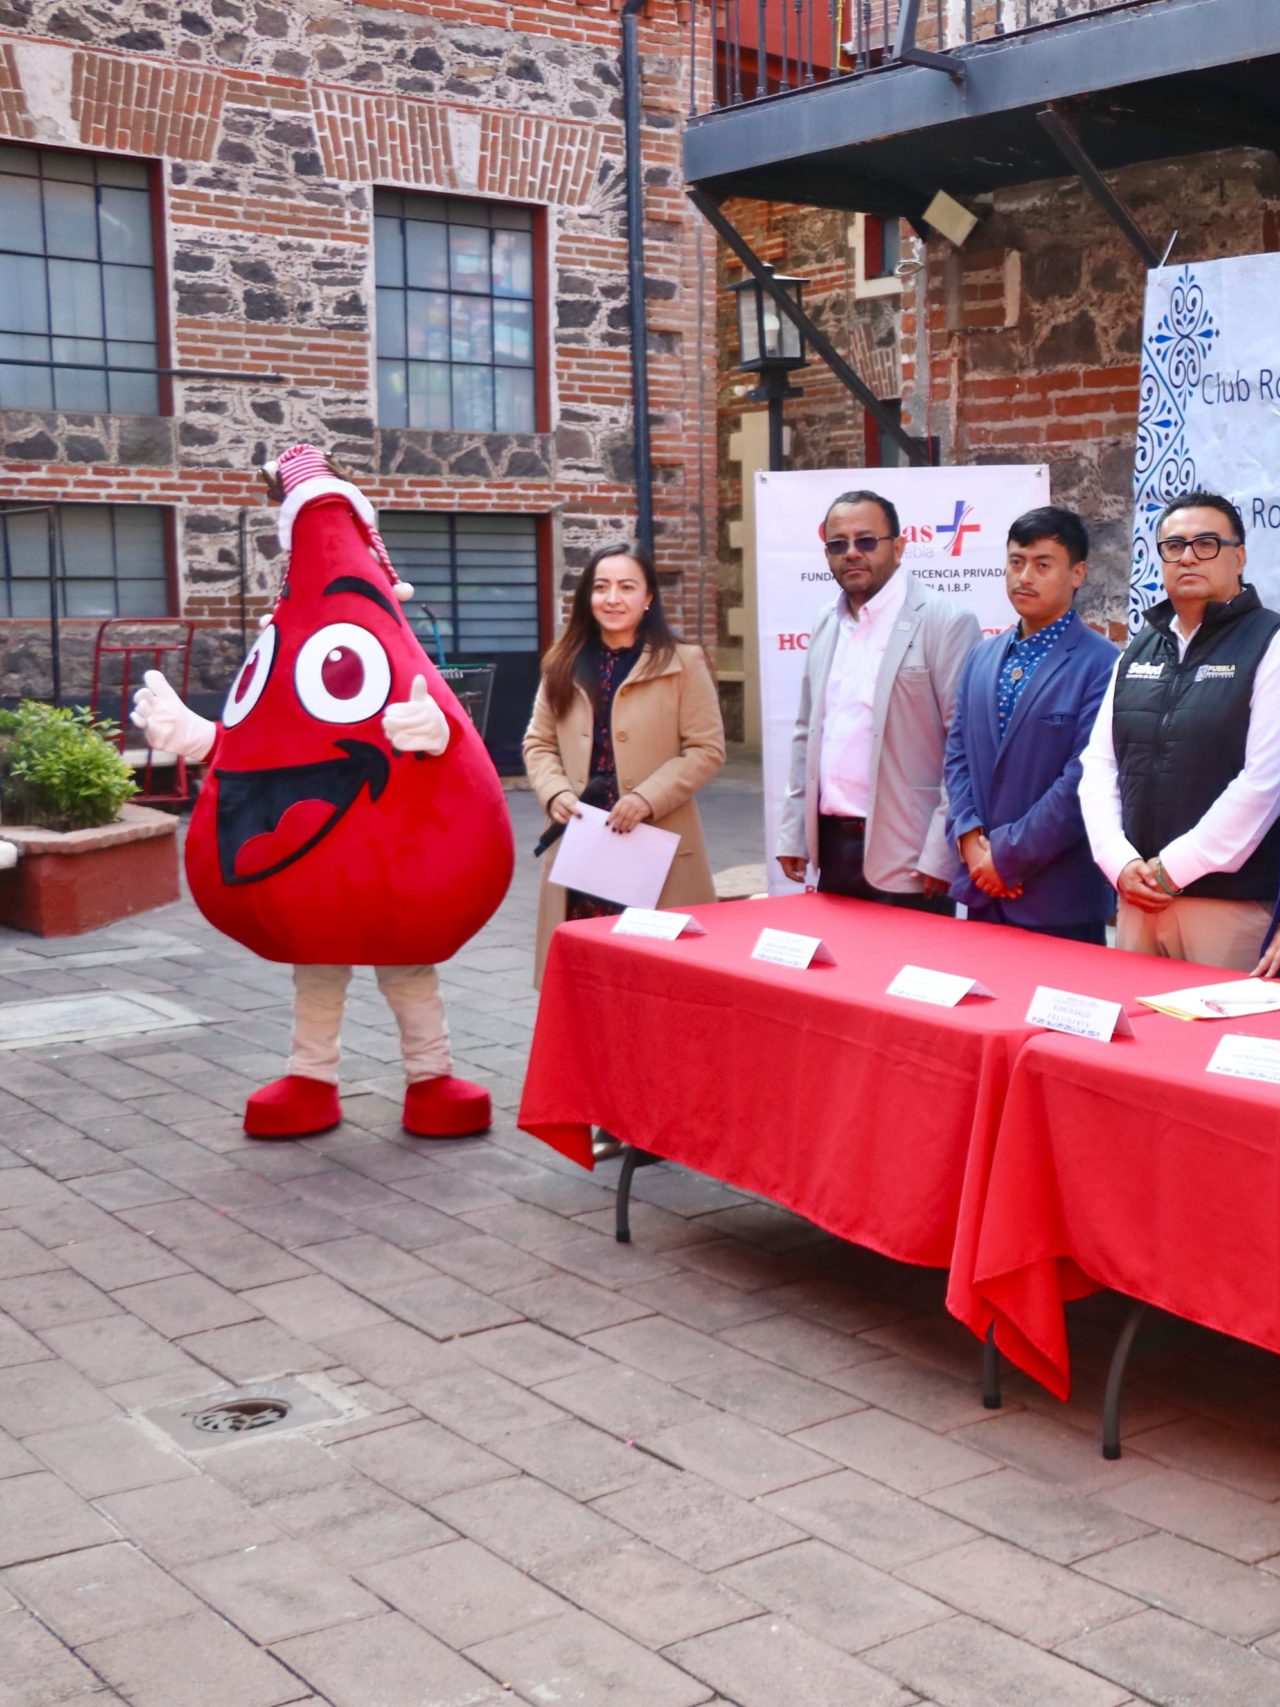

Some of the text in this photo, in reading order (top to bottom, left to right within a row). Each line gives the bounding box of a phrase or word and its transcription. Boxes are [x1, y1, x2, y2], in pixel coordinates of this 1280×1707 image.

[1201, 369, 1251, 405] Club
[905, 544, 934, 559] ebla
[948, 583, 972, 593] I.B.P.
[1128, 662, 1165, 674] Salud
